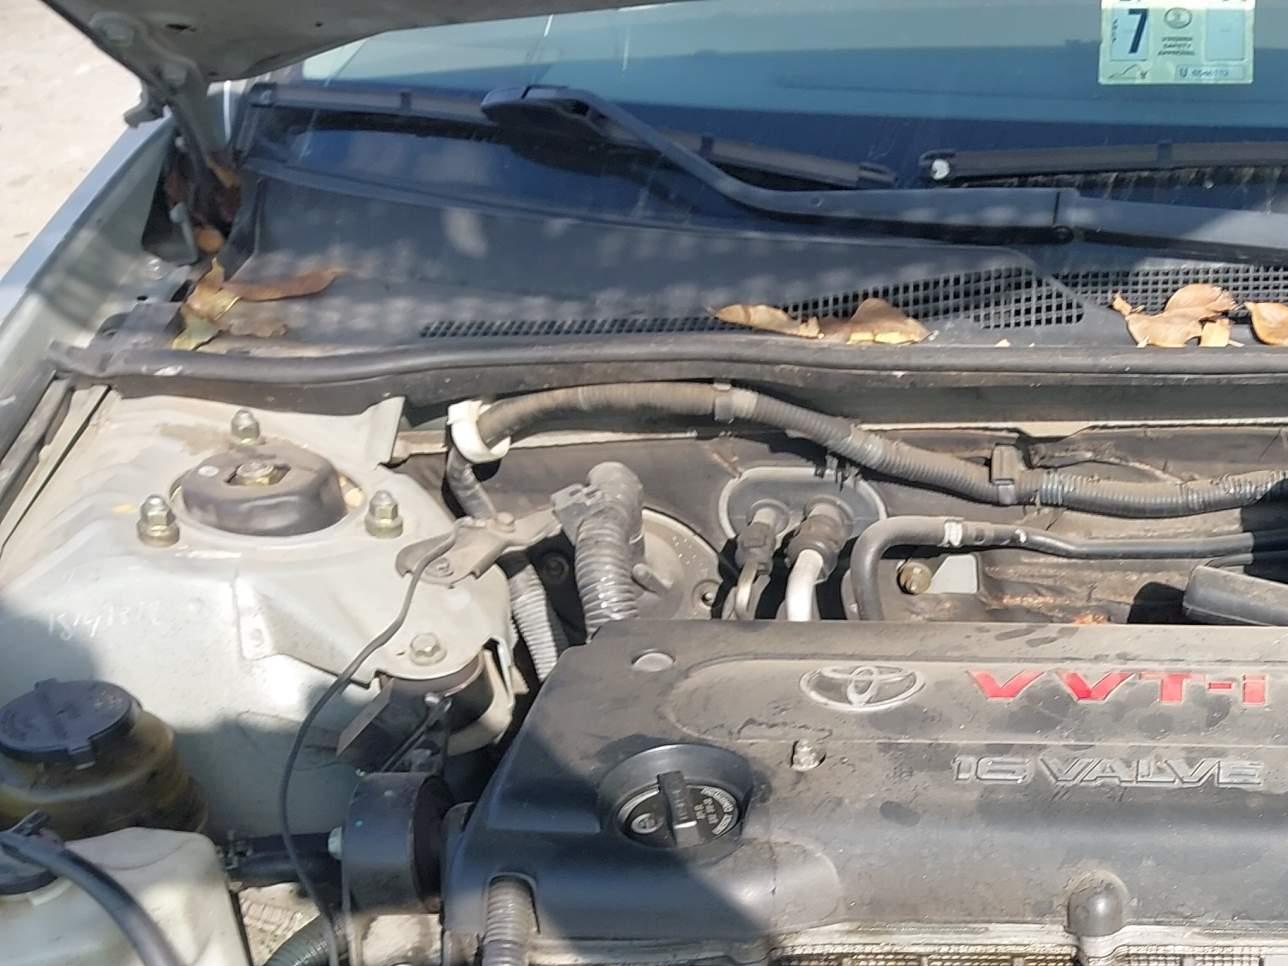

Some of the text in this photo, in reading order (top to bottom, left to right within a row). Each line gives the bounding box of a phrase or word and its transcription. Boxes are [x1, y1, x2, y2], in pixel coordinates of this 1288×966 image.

[1128, 8, 1149, 54] 7
[967, 671, 1266, 704] VVT-i
[952, 756, 1265, 787] 16 VALVE
